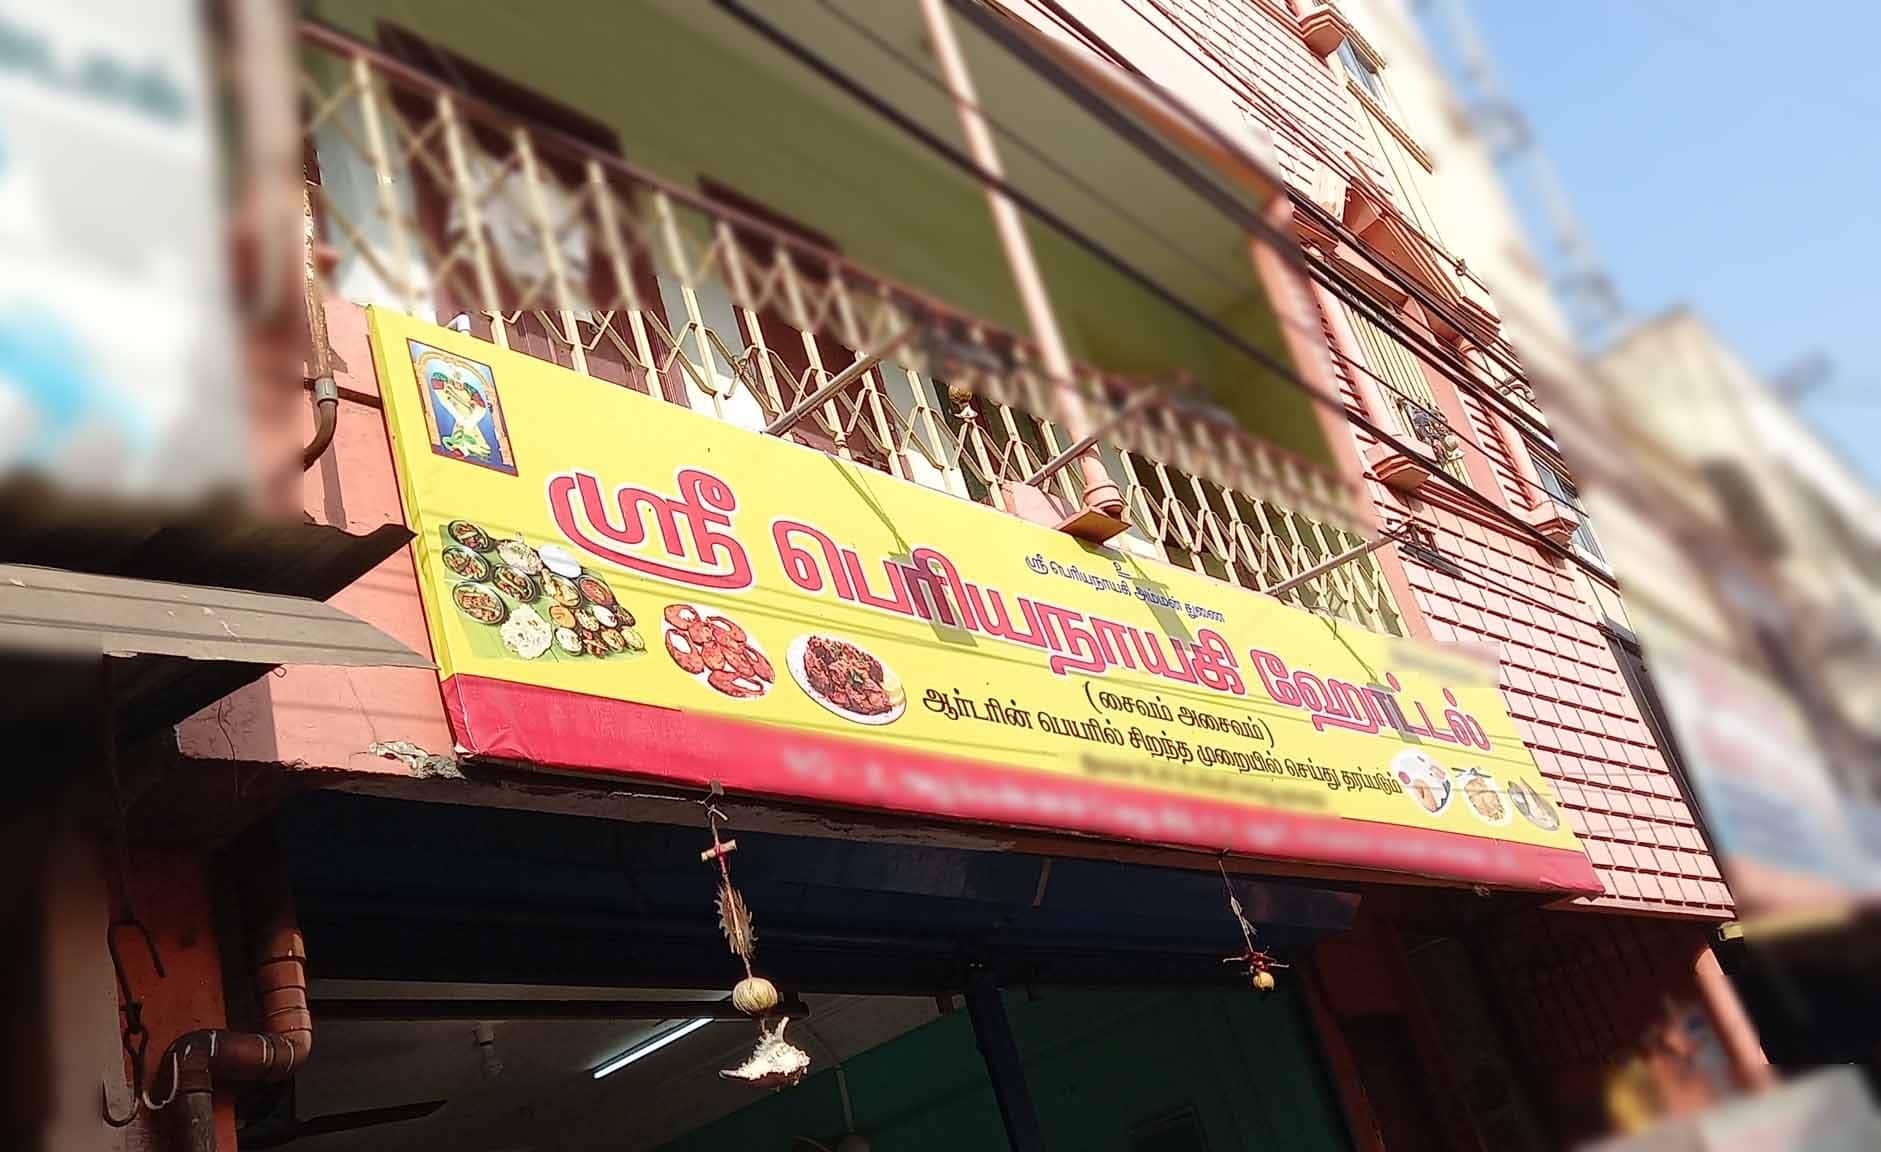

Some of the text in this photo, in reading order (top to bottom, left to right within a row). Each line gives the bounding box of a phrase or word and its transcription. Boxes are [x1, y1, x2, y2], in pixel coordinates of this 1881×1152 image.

[548, 469, 1491, 751] ஸ்ரீ பெரியநாயகி ஹோட்டல்
[1049, 560, 1132, 596] பெரியநாயகி
[1134, 586, 1182, 612] அம்மன்
[922, 687, 1034, 729] ஆர்டரின்
[1037, 711, 1125, 747] பெயரில்
[1127, 725, 1194, 765] சிறந்த
[1197, 745, 1284, 775] முறையில்
[1284, 757, 1342, 790] செய்து
[1340, 766, 1404, 796] தரப்படும்
